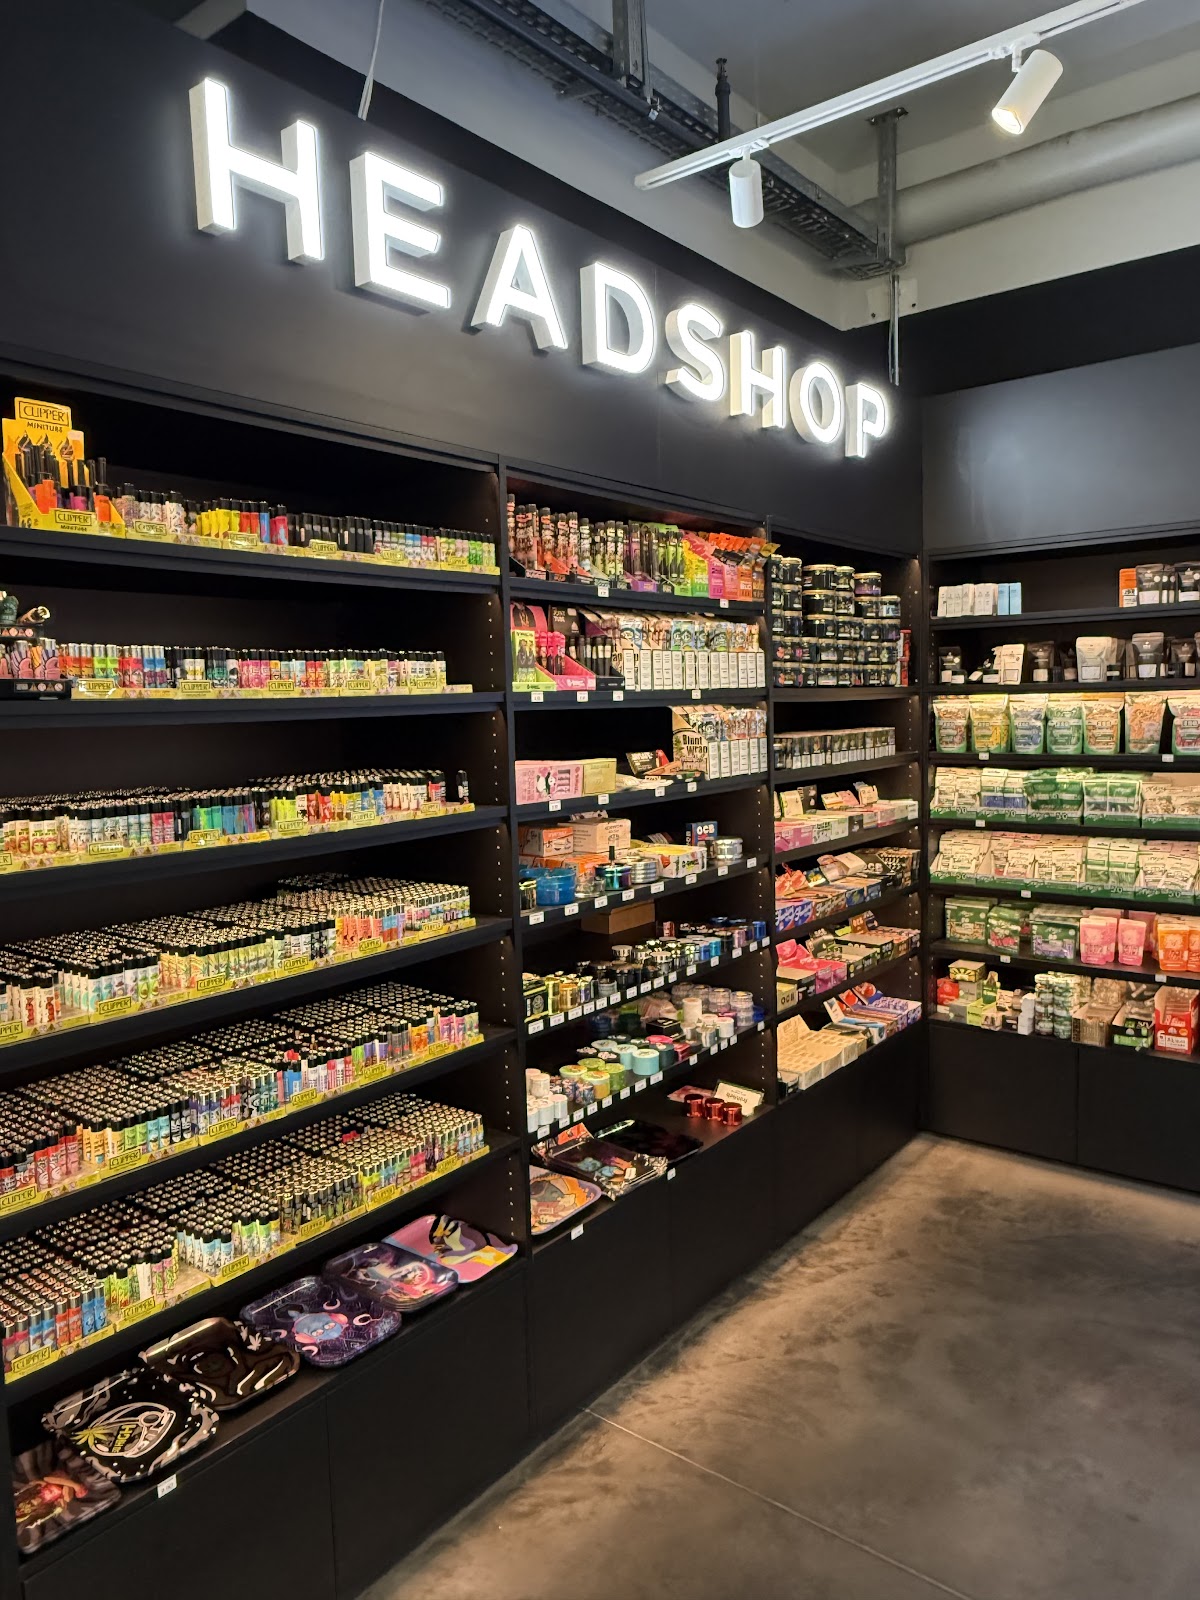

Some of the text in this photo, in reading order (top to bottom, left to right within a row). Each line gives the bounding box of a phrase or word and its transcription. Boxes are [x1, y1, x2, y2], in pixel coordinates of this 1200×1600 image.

[189, 77, 887, 457] HEADSHOP
[23, 405, 65, 421] CLIPPER
[57, 513, 89, 524] CLIPPER
[682, 734, 702, 745] Blunt
[696, 824, 715, 836] OCB
[100, 999, 130, 1013] CLIPPER
[111, 1151, 140, 1168] CLIPPER
